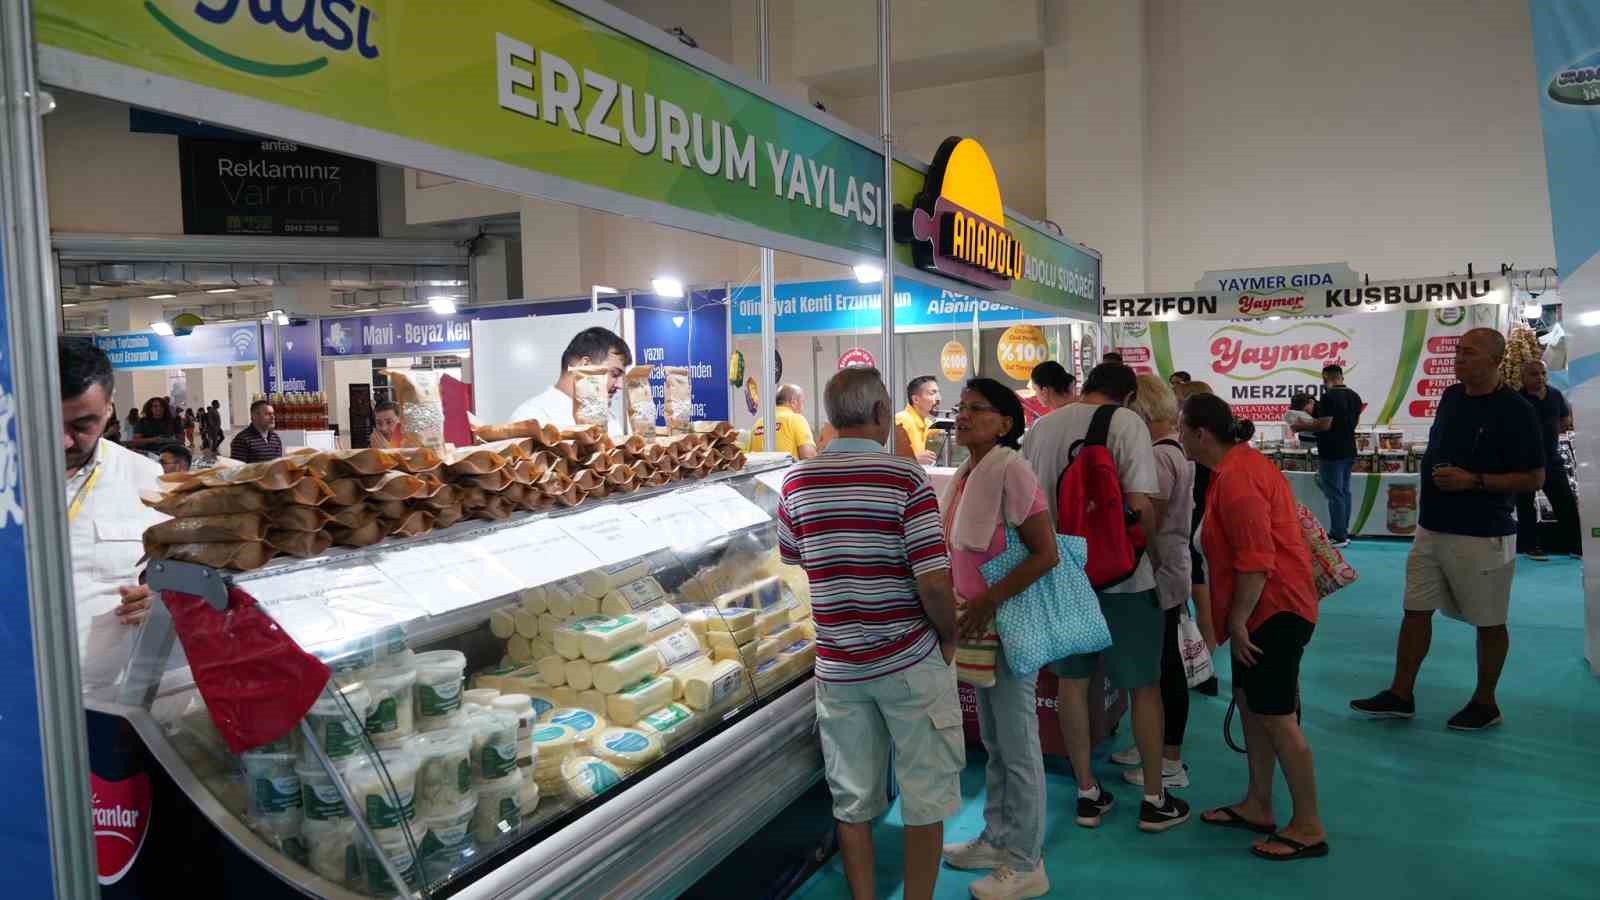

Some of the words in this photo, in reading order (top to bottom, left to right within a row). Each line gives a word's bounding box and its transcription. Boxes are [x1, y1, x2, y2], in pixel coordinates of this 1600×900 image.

[495, 31, 757, 188] ERZURUM
[766, 141, 882, 229] YAYLASI
[218, 158, 341, 181] Reklamınız
[953, 211, 1025, 281] ANADOLU
[1023, 254, 1057, 288] ADOLU
[1218, 275, 1286, 292] YAYMER
[1291, 273, 1334, 288] GIDA
[800, 293, 833, 313] Kenti
[1237, 294, 1304, 316] Yaymer
[363, 323, 394, 346] Mavi
[404, 322, 444, 346] Beyaz
[446, 319, 471, 342] Ken
[999, 343, 1048, 363] %100
[1210, 337, 1349, 375] Yaymer
[91, 804, 139, 828] ranlar
